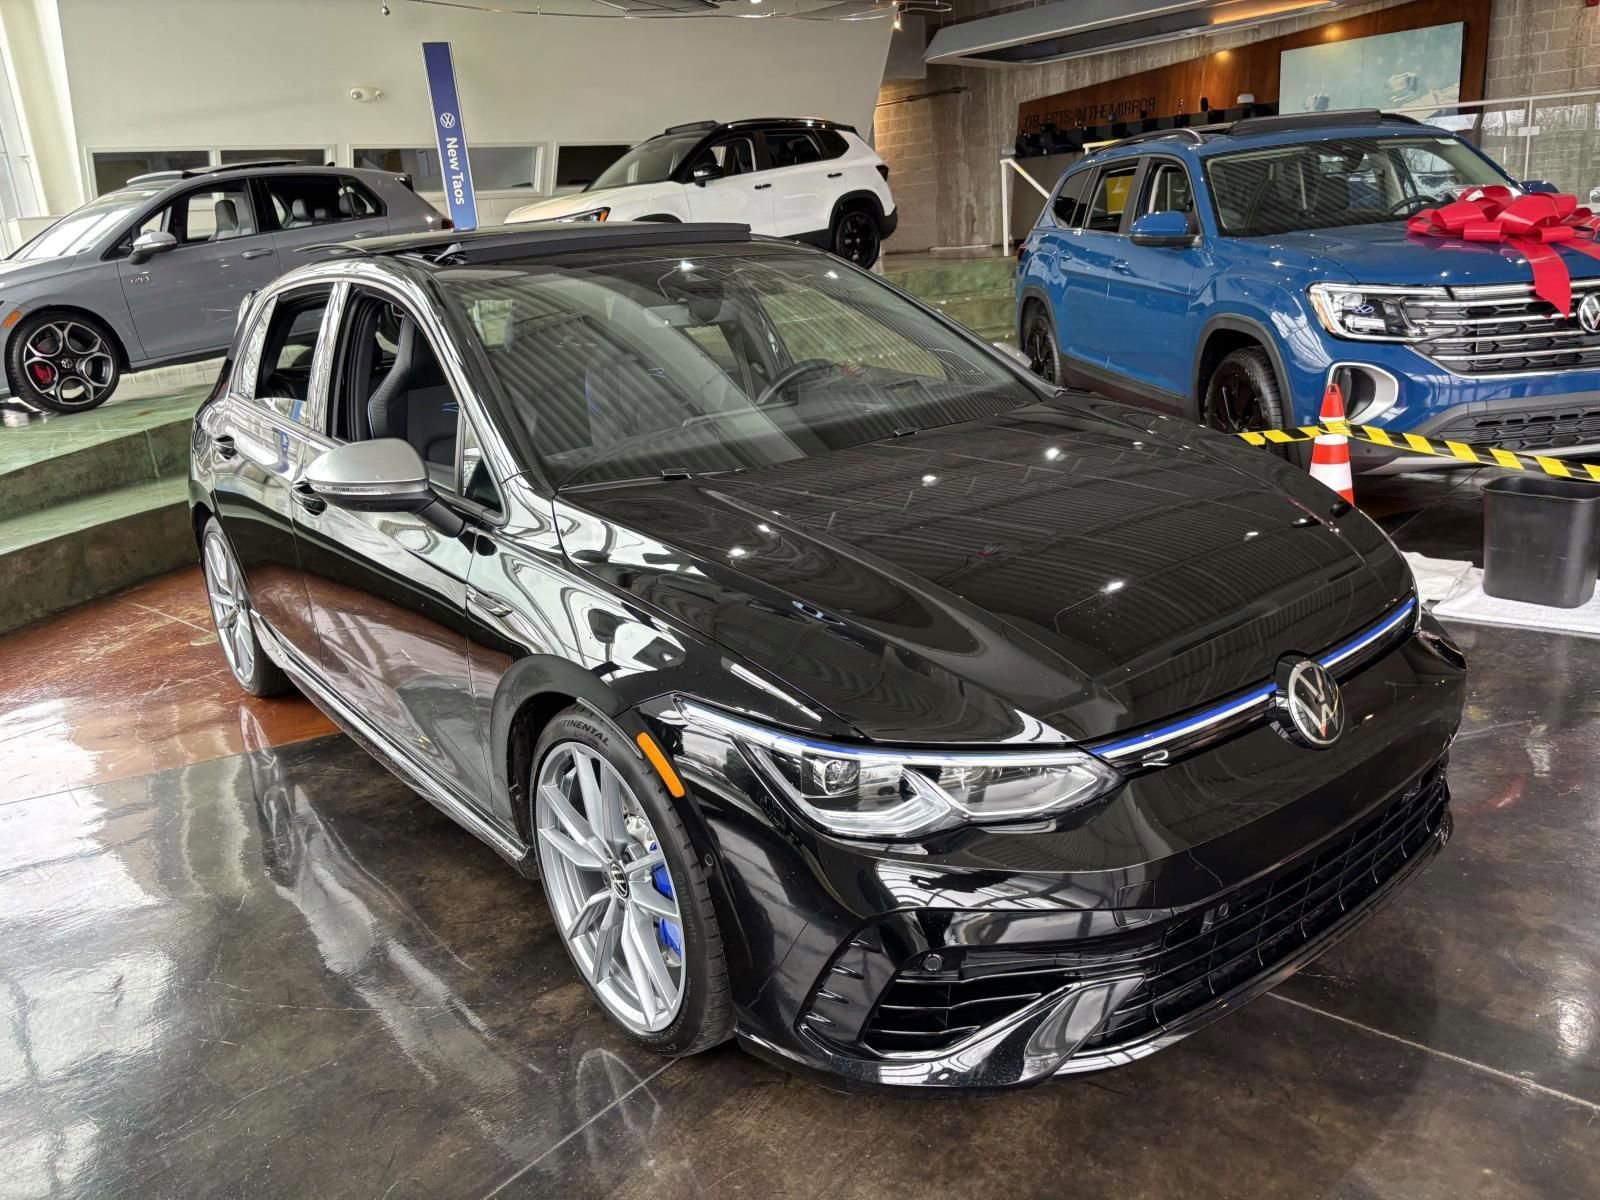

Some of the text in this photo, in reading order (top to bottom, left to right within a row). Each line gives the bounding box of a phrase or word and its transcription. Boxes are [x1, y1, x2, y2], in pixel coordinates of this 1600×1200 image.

[1088, 104, 1108, 120] THE
[1109, 97, 1156, 116] MIRROR
[446, 137, 465, 205] New Taos
[557, 719, 609, 746] TINENTAL
